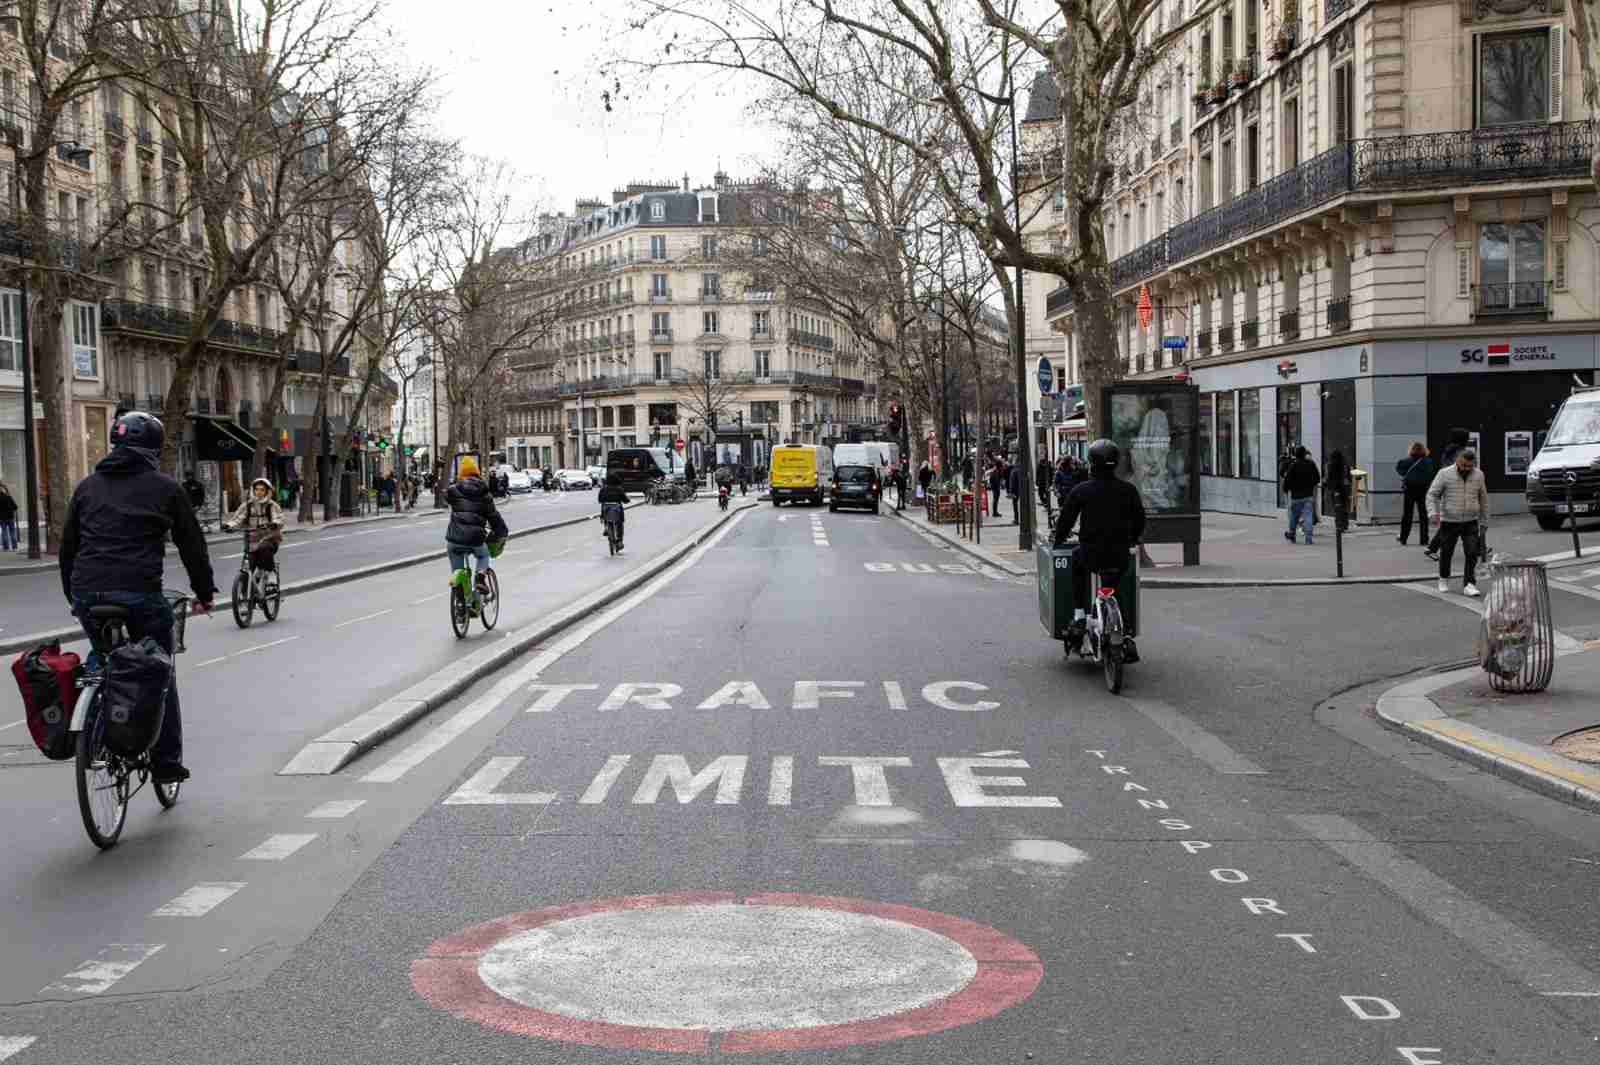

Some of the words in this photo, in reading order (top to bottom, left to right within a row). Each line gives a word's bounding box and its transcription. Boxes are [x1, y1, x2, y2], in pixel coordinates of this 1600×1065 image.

[1461, 349, 1484, 363] SG
[1055, 557, 1068, 569] 60
[524, 680, 1001, 712] TRAFIC
[442, 750, 1063, 808] LIMITÉ
[1084, 750, 1318, 954] TRANSPORT
